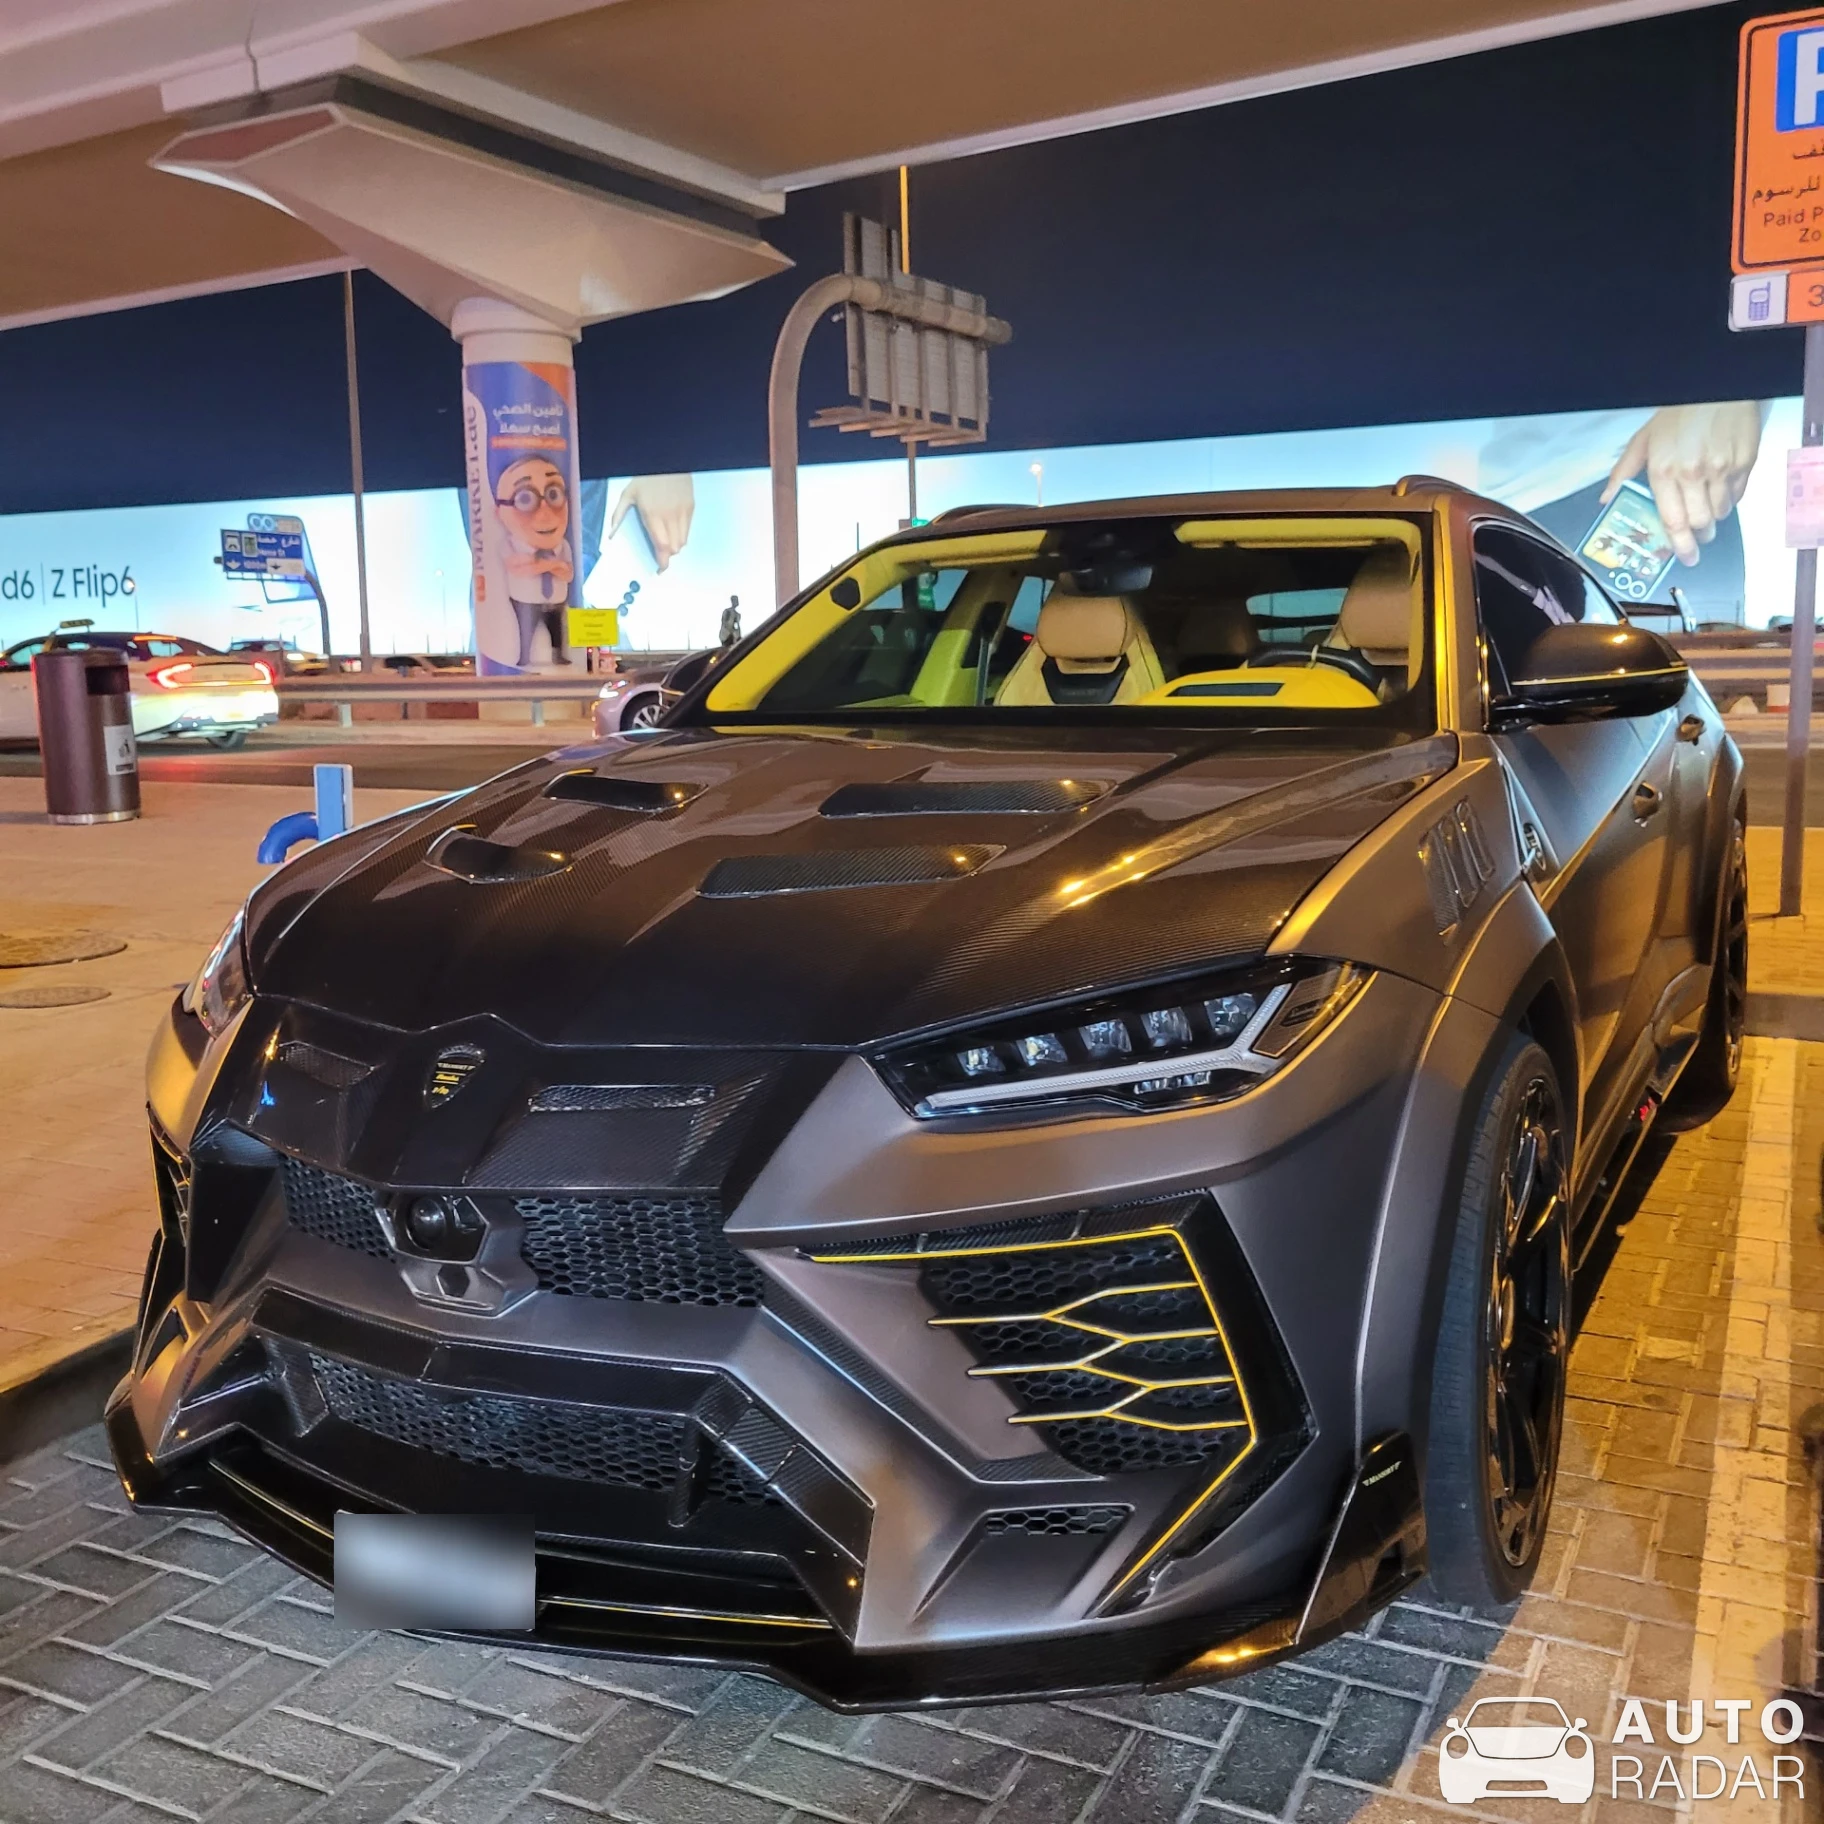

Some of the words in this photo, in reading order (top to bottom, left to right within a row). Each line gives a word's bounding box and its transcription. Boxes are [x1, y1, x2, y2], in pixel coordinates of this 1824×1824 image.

[1752, 174, 1821, 206] للرسوم
[1763, 208, 1805, 228] Paid
[2, 570, 35, 600] d6
[51, 569, 66, 598] Z
[73, 564, 136, 608] Flip6
